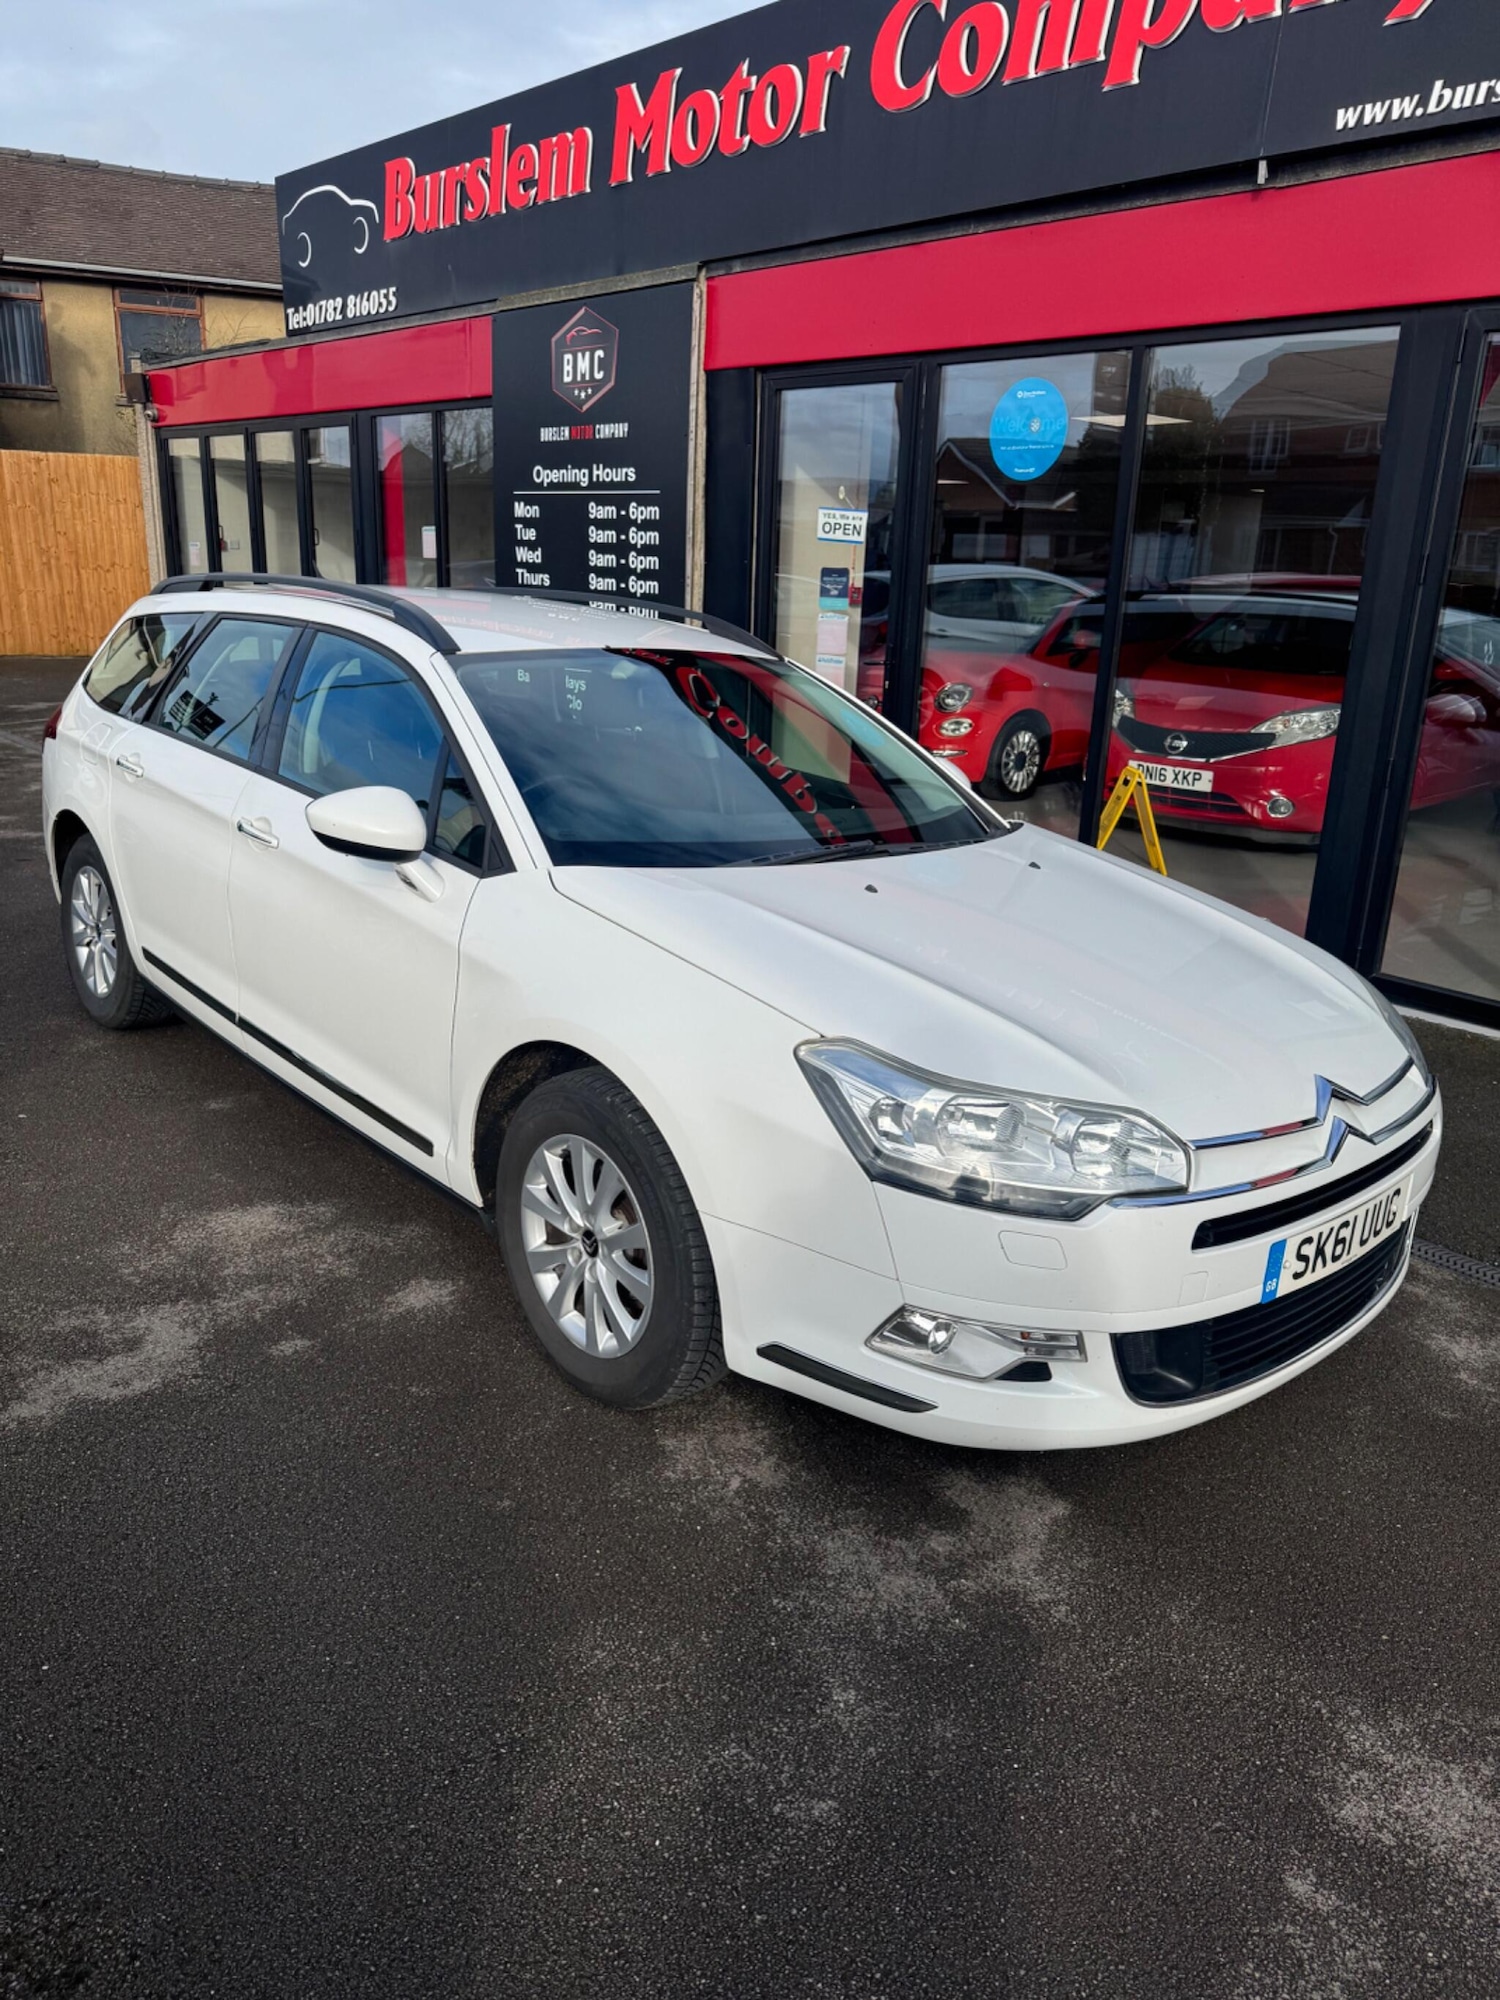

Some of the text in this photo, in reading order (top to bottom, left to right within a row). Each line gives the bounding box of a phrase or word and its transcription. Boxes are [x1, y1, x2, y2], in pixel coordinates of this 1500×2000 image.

[383, 0, 1433, 242] Burslem Motor Comp
[286, 286, 398, 330] Tel:01782 816055
[563, 349, 605, 384] BMC
[540, 422, 629, 442] BURSLEM MOTOR COMPANY
[532, 463, 637, 487] Opening Hours
[513, 501, 540, 518] Mon
[588, 502, 617, 520] 9am
[628, 502, 660, 524] 6pm
[514, 524, 537, 541] Tue
[588, 525, 617, 544] 9am
[628, 526, 660, 549] 6pm
[822, 521, 862, 537] OPEN
[515, 546, 542, 564] Wed
[588, 549, 617, 568] 9am
[628, 551, 660, 574] 6pm
[515, 568, 551, 587] Thurs
[588, 573, 617, 592] 9am
[628, 575, 660, 598] 6pm
[1171, 769, 1202, 787] XKP
[1292, 1188, 1402, 1280] SK61 UUG
[1265, 1278, 1278, 1293] GB
